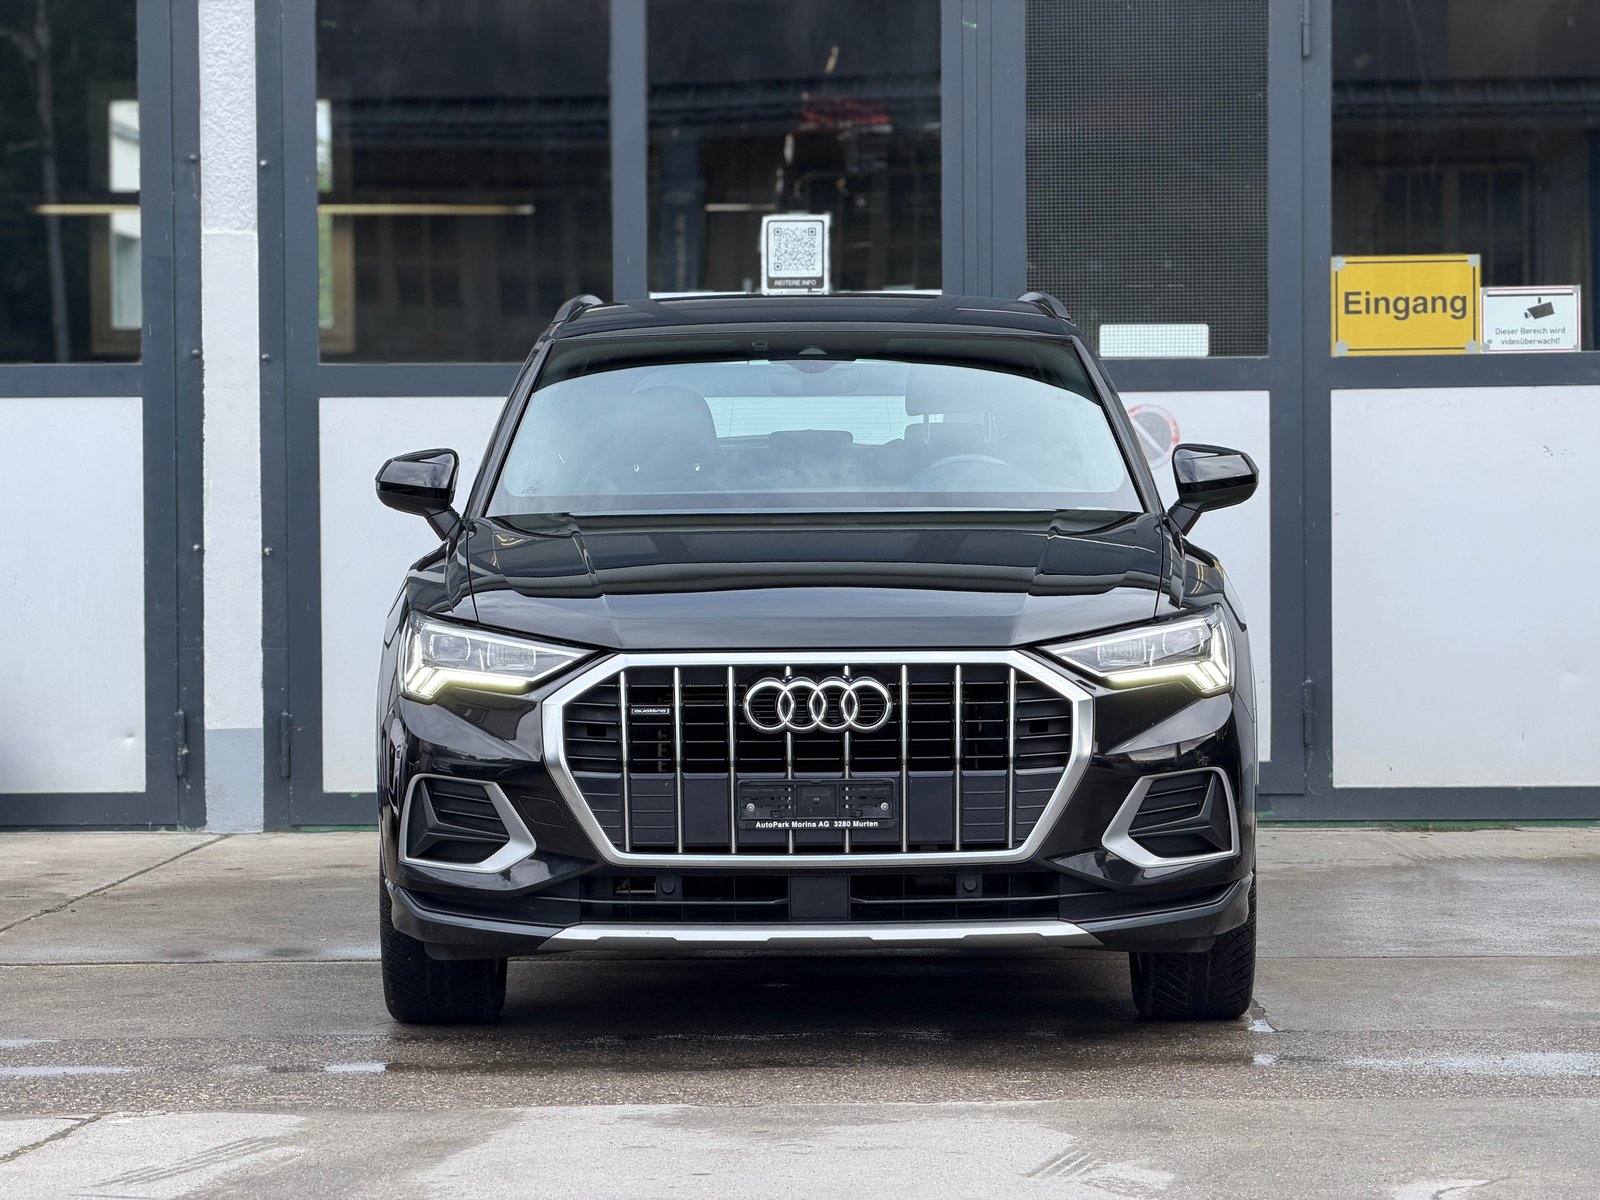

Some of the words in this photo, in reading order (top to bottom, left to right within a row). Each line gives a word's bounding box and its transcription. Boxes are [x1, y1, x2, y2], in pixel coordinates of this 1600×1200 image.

[1344, 291, 1467, 321] Eingang
[1520, 327, 1548, 335] Bereich
[1501, 337, 1561, 345] videoüberwacht!
